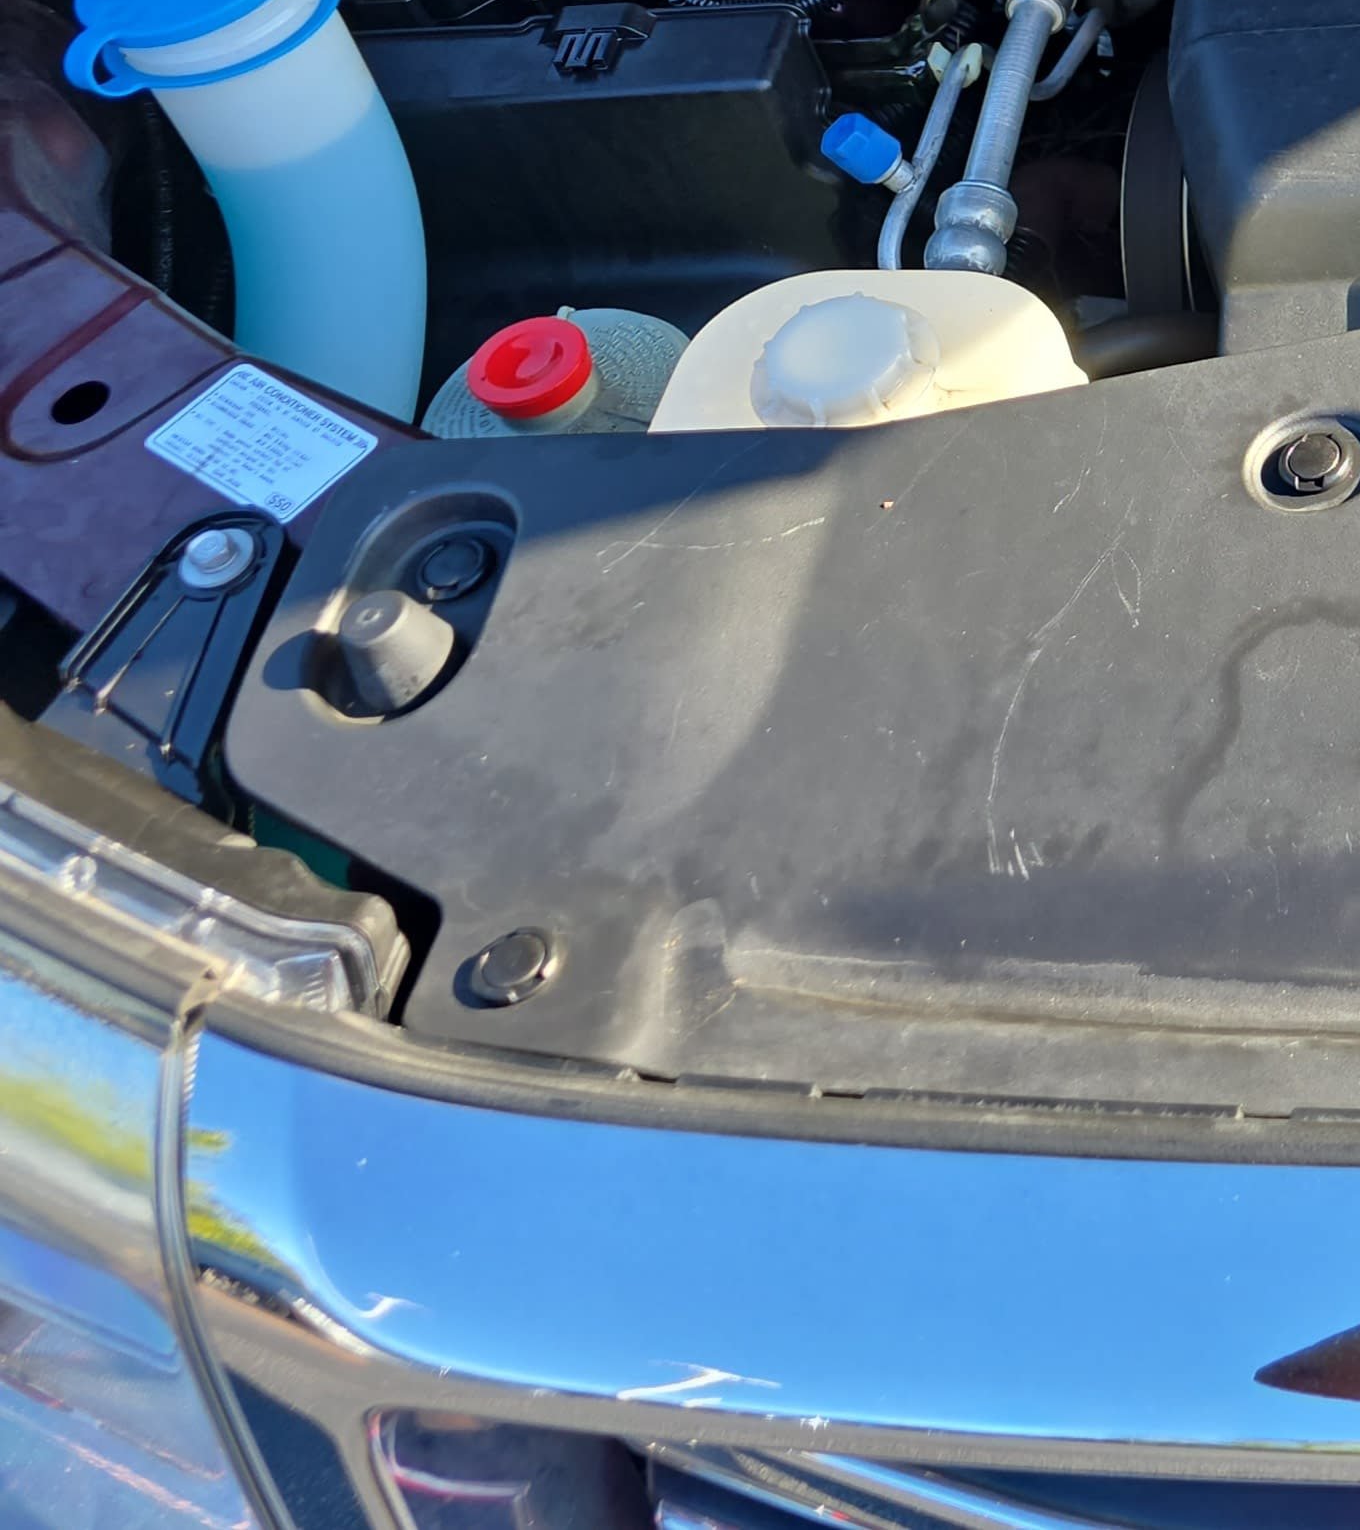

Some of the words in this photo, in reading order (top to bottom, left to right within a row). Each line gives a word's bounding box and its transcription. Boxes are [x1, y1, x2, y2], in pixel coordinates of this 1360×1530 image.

[247, 375, 269, 390] AIR
[260, 384, 326, 422] CONDITIONER
[317, 416, 360, 443] SYSTEM
